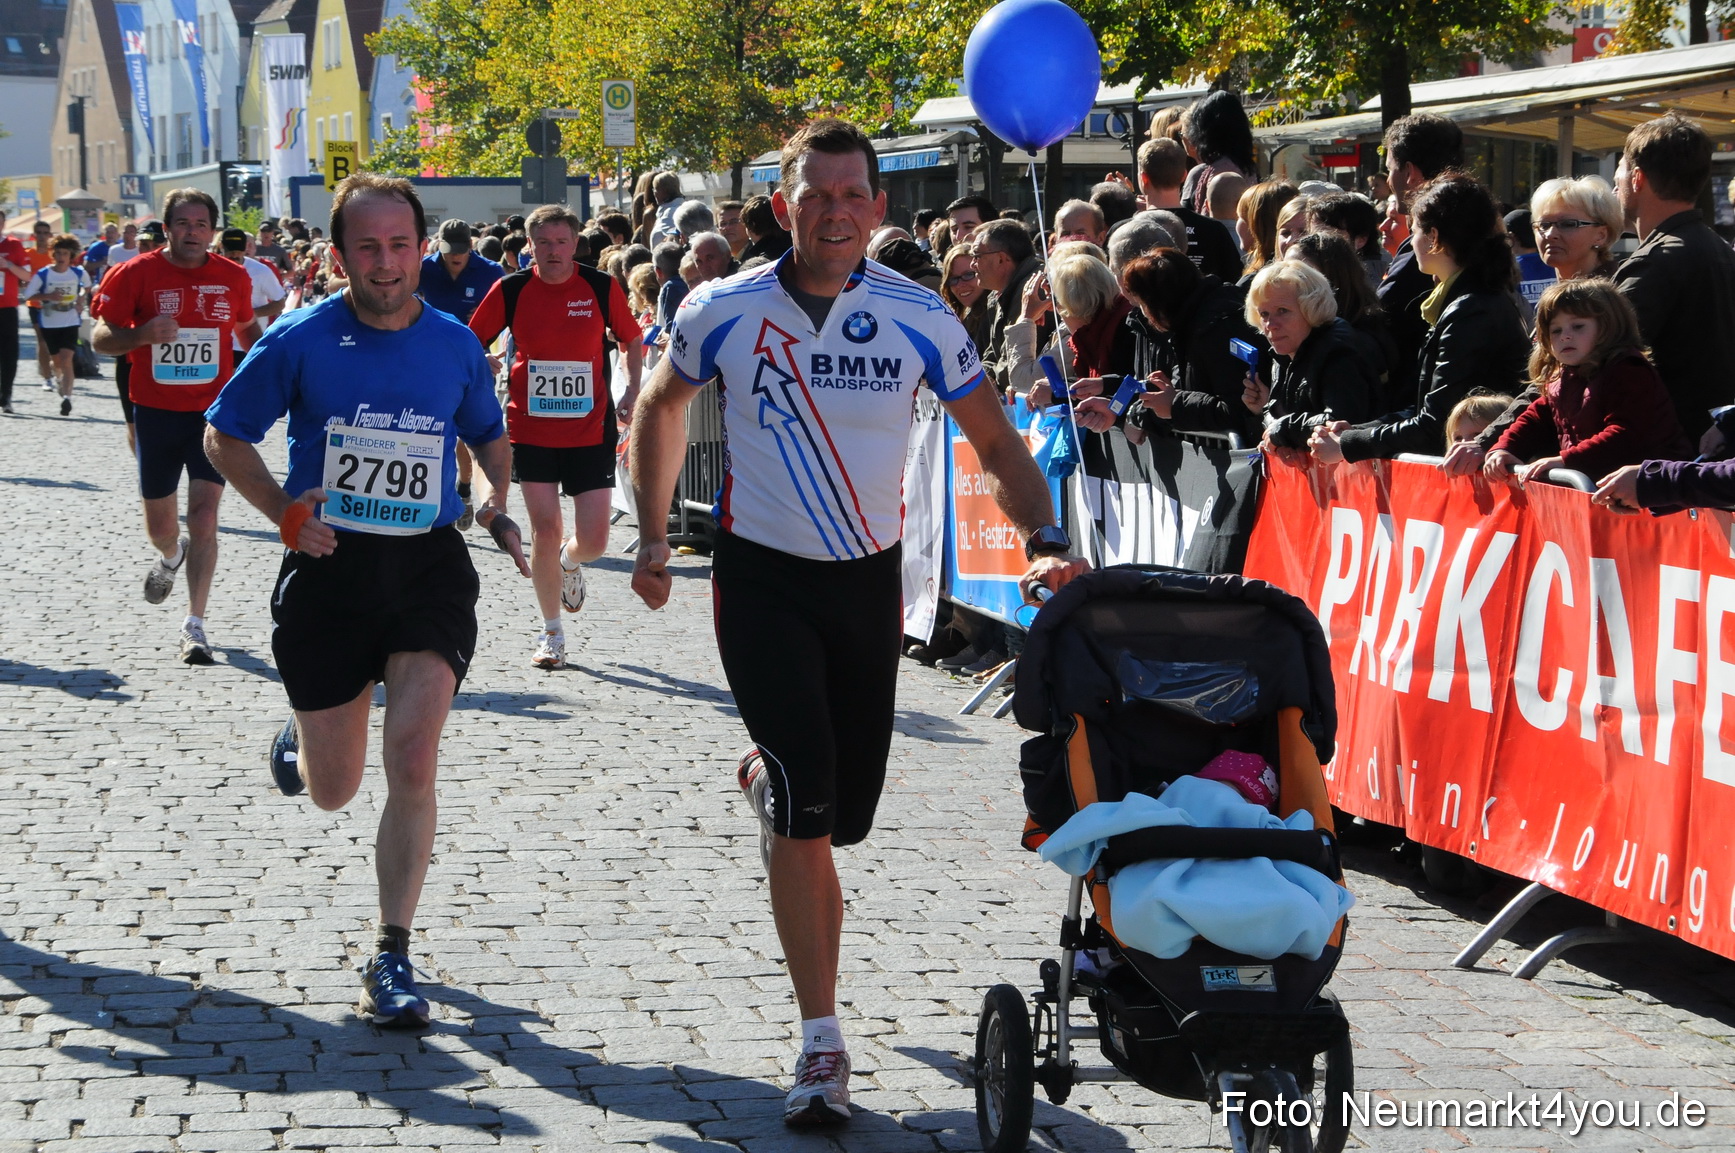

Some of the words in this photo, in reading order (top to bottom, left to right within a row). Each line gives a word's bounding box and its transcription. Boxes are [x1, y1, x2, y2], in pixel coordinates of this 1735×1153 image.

[327, 143, 355, 153] Block
[333, 156, 350, 181] B
[160, 302, 179, 310] NEU
[567, 299, 593, 308] Lauftreff
[567, 310, 593, 318] Parsberg
[160, 343, 212, 364] 2076
[174, 366, 200, 377] Fritz
[811, 353, 903, 379] BMW
[535, 375, 586, 397] 2160
[811, 377, 903, 393] RADSPORT
[539, 398, 584, 411] Günther
[345, 434, 396, 450] PFLEIDERER
[336, 453, 429, 500] 2798
[974, 472, 991, 496] au
[340, 494, 421, 523] Sellerer
[1239, 775, 1265, 801] Hello
[1543, 803, 1735, 932] loung
[1205, 969, 1237, 981] TFK
